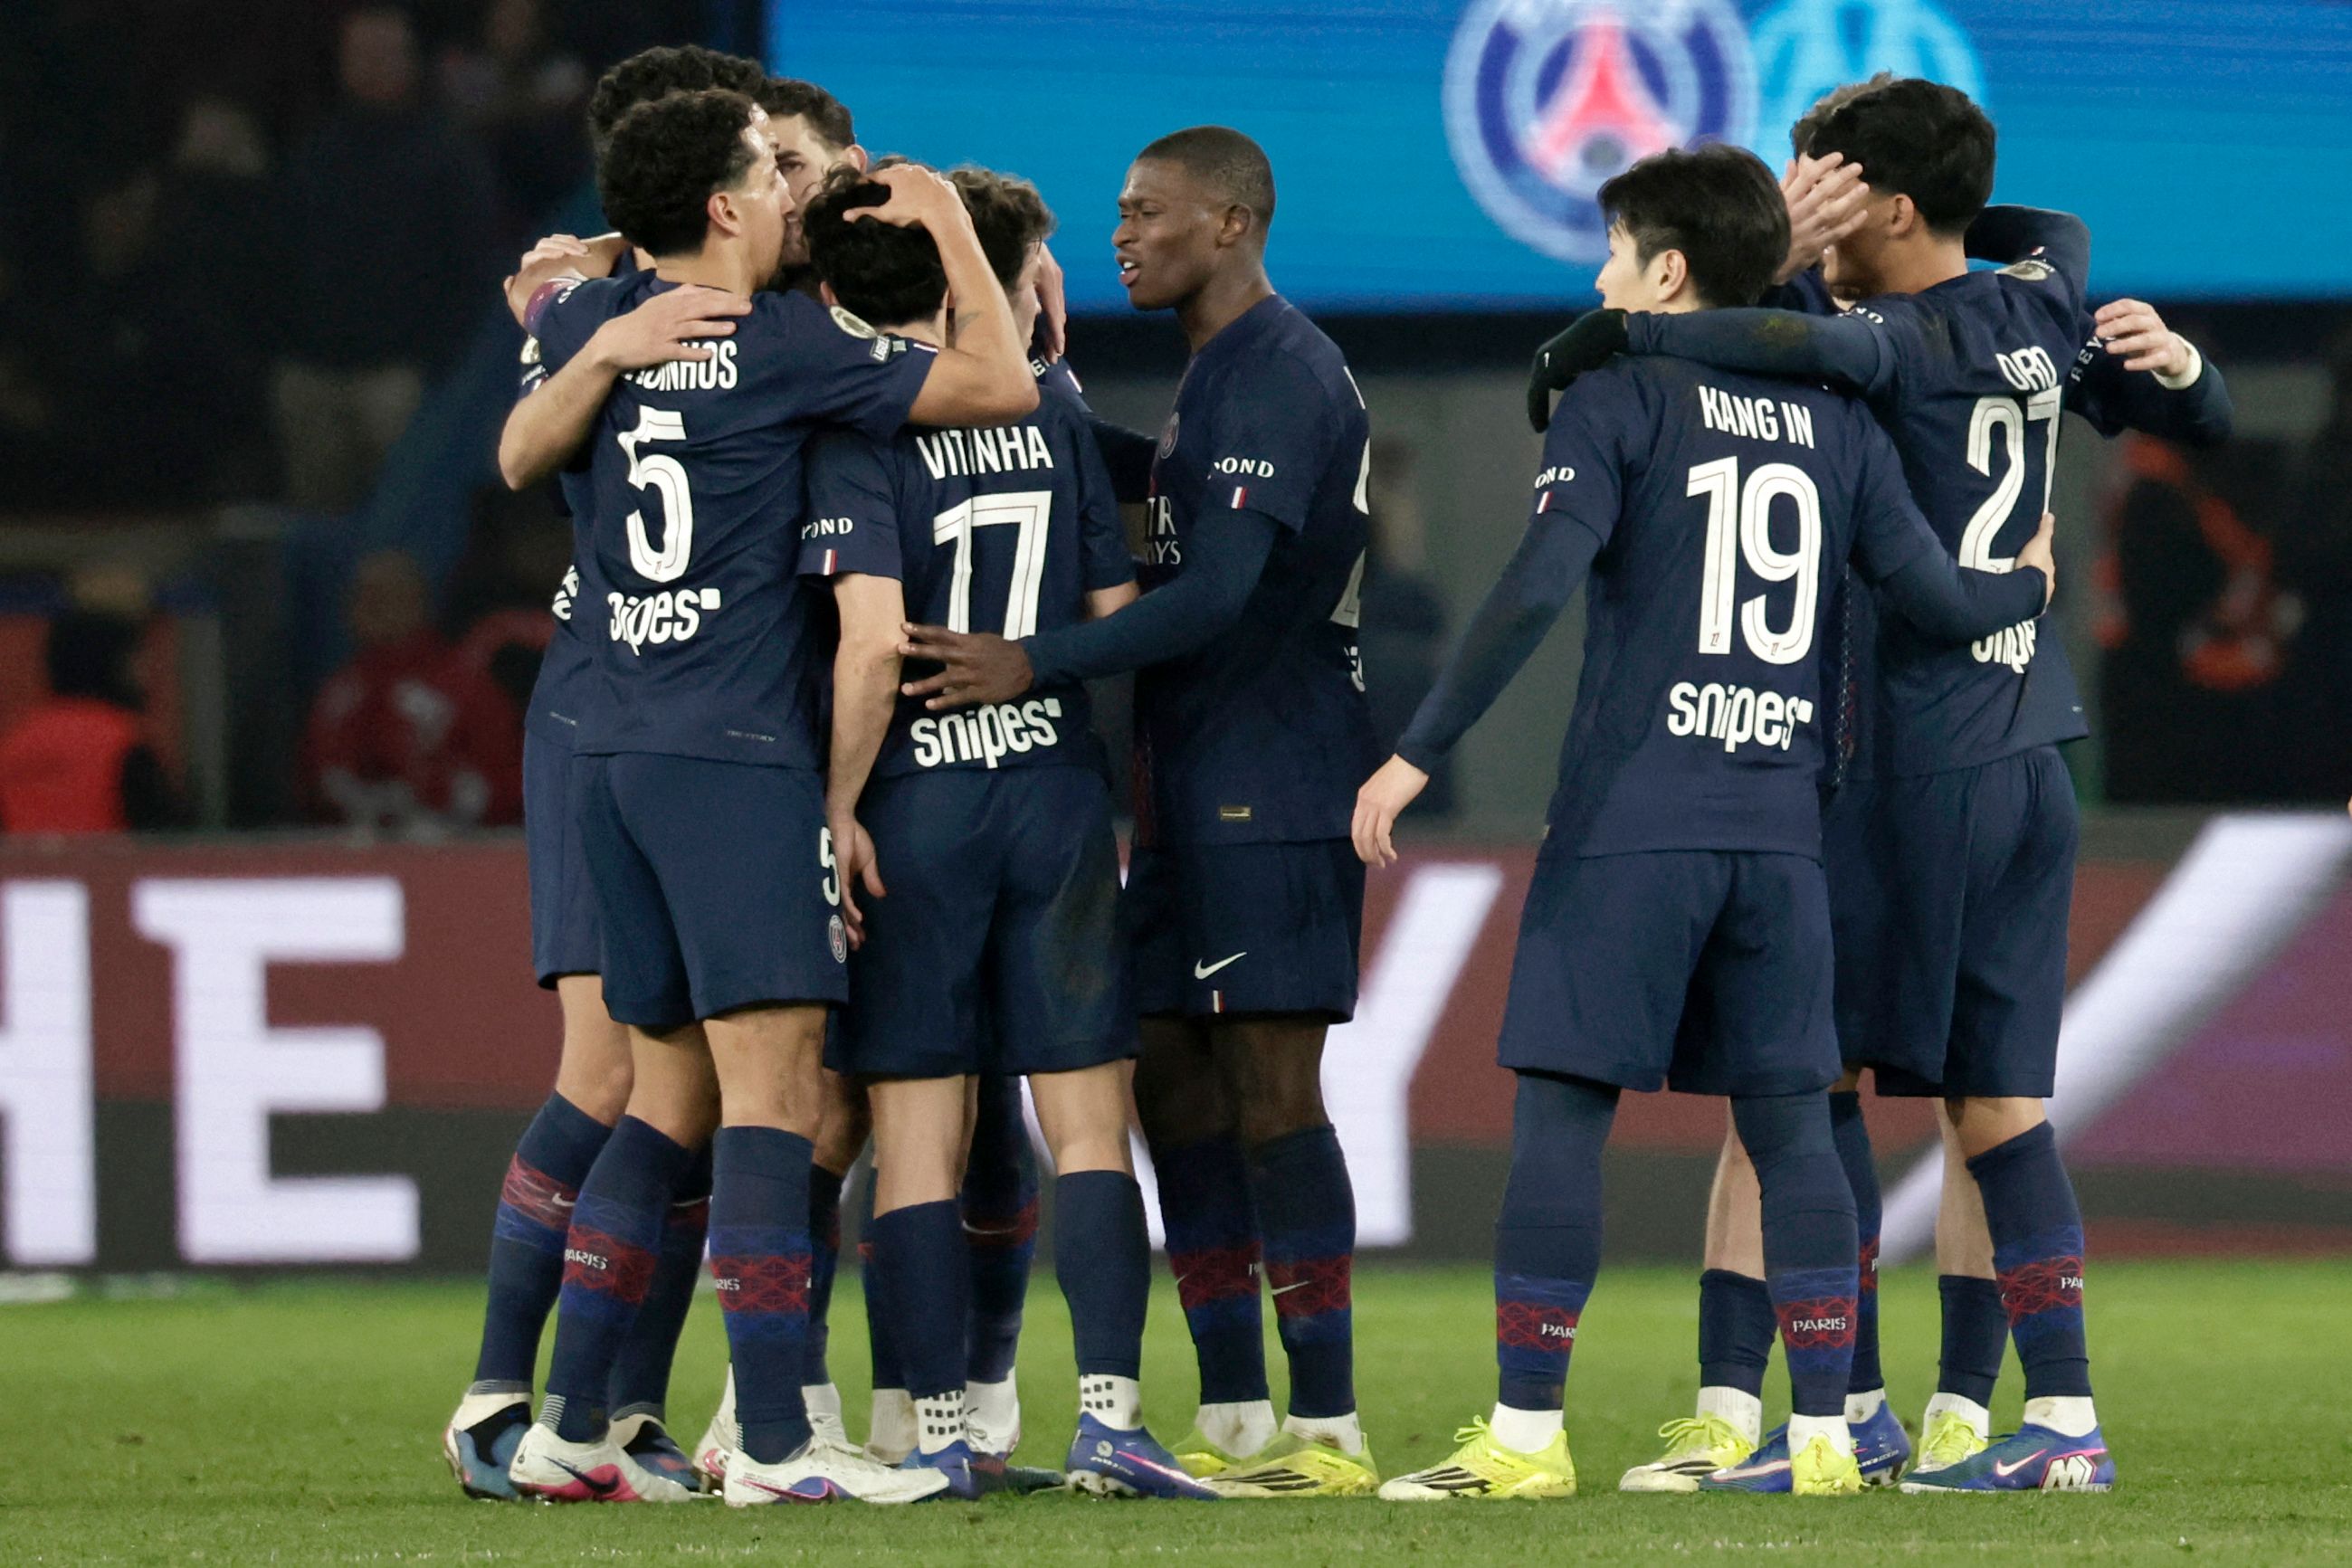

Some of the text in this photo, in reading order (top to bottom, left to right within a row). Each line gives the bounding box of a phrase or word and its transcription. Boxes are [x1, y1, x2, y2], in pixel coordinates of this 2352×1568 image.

[915, 424, 1055, 480] VITINHA
[1698, 385, 1815, 450] KANG IN
[617, 404, 693, 584] 5
[1958, 384, 2062, 575] 27
[933, 489, 1052, 641] 17
[1685, 455, 1823, 666] 19
[909, 698, 1058, 769] snipes
[1666, 680, 1800, 753] snipes
[820, 826, 841, 907] 5
[1793, 1316, 1846, 1333] PARIS
